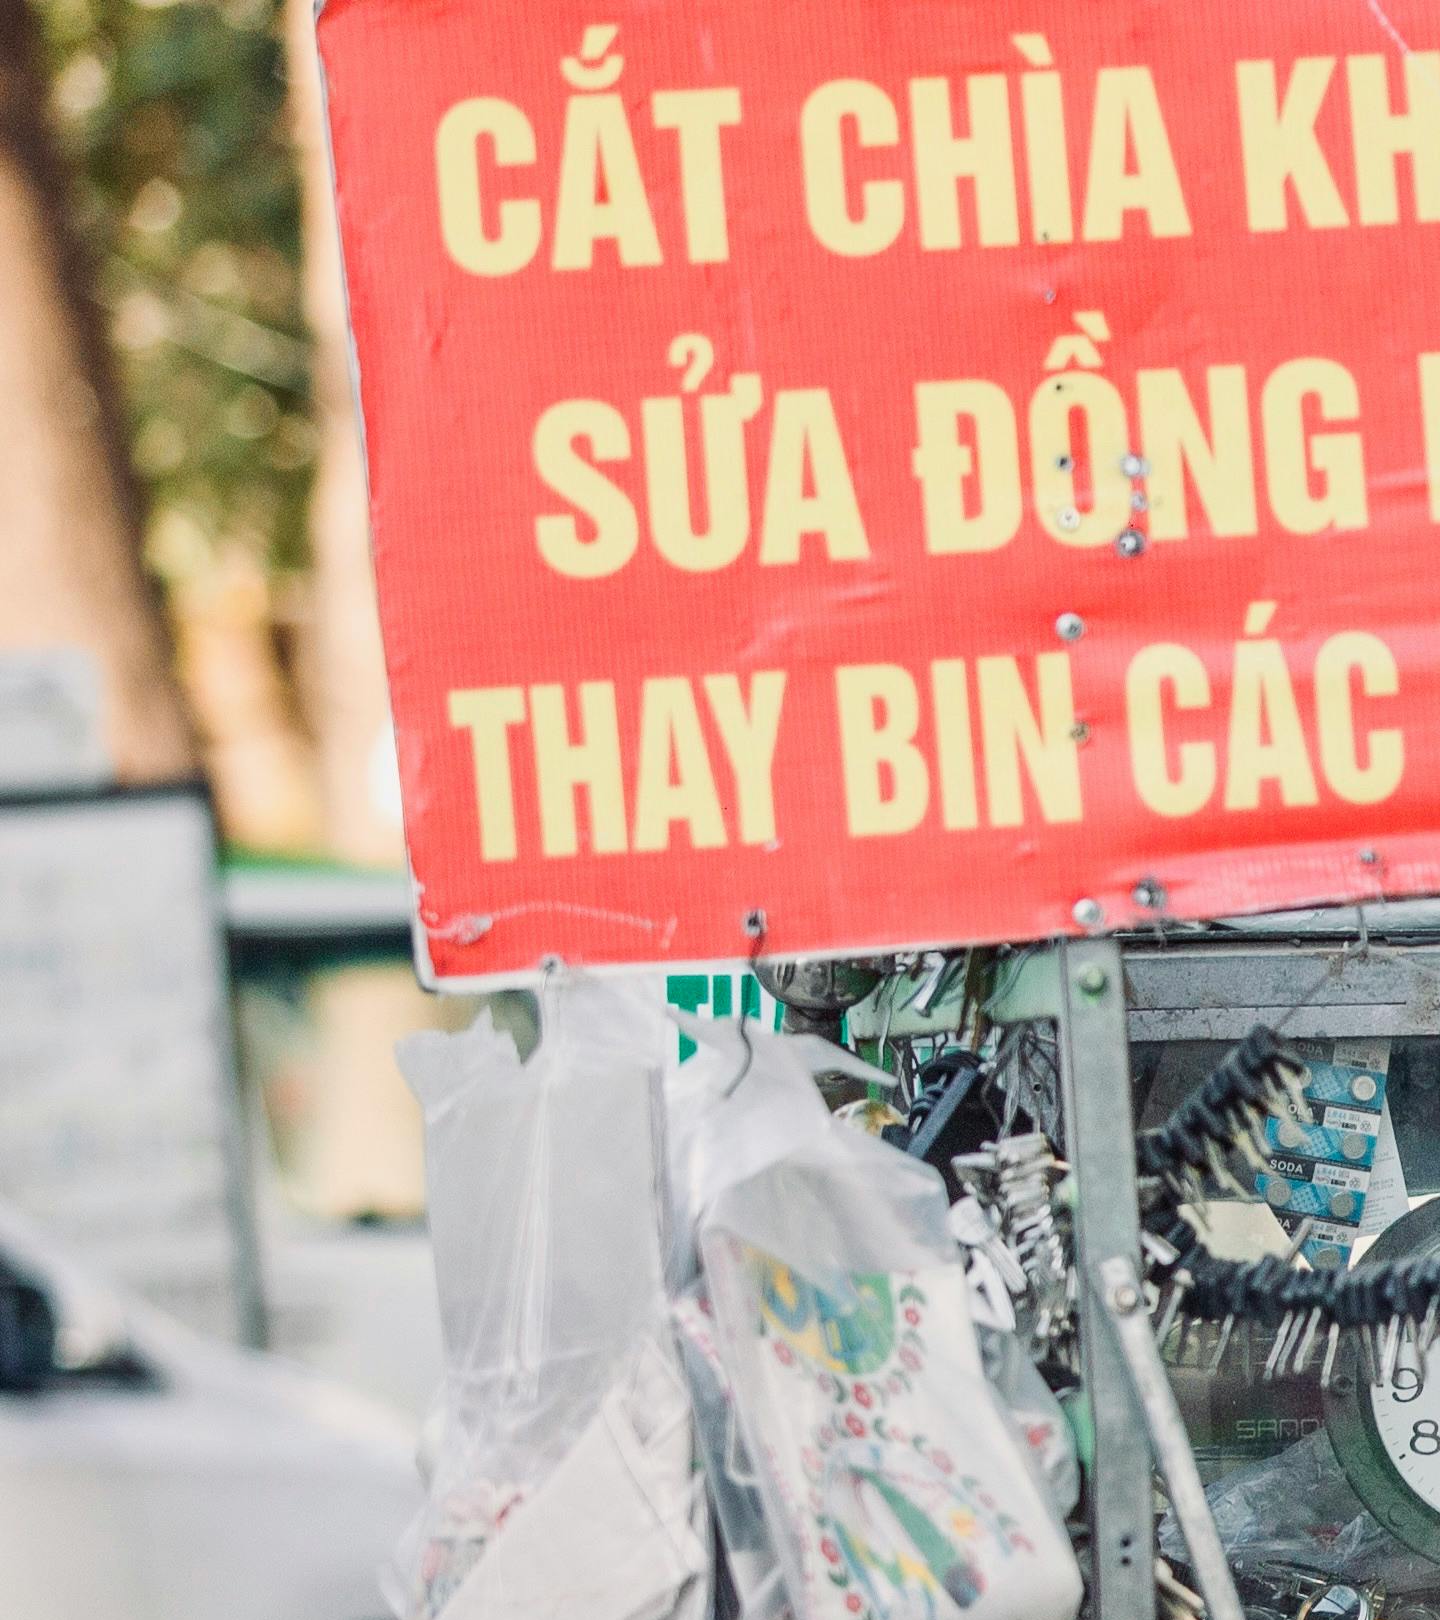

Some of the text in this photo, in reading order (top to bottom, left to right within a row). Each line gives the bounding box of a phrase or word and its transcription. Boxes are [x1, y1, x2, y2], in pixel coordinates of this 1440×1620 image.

[434, 24, 743, 278] CẮT
[799, 32, 1193, 257] CHÌA
[532, 333, 871, 579] SỬA
[911, 310, 1370, 556] ĐỒNG
[447, 670, 787, 862] THAY
[835, 650, 1080, 838] BIN
[1124, 600, 1405, 818] CÁC
[1269, 1158, 1304, 1175] SODA
[1391, 1366, 1425, 1403] 9
